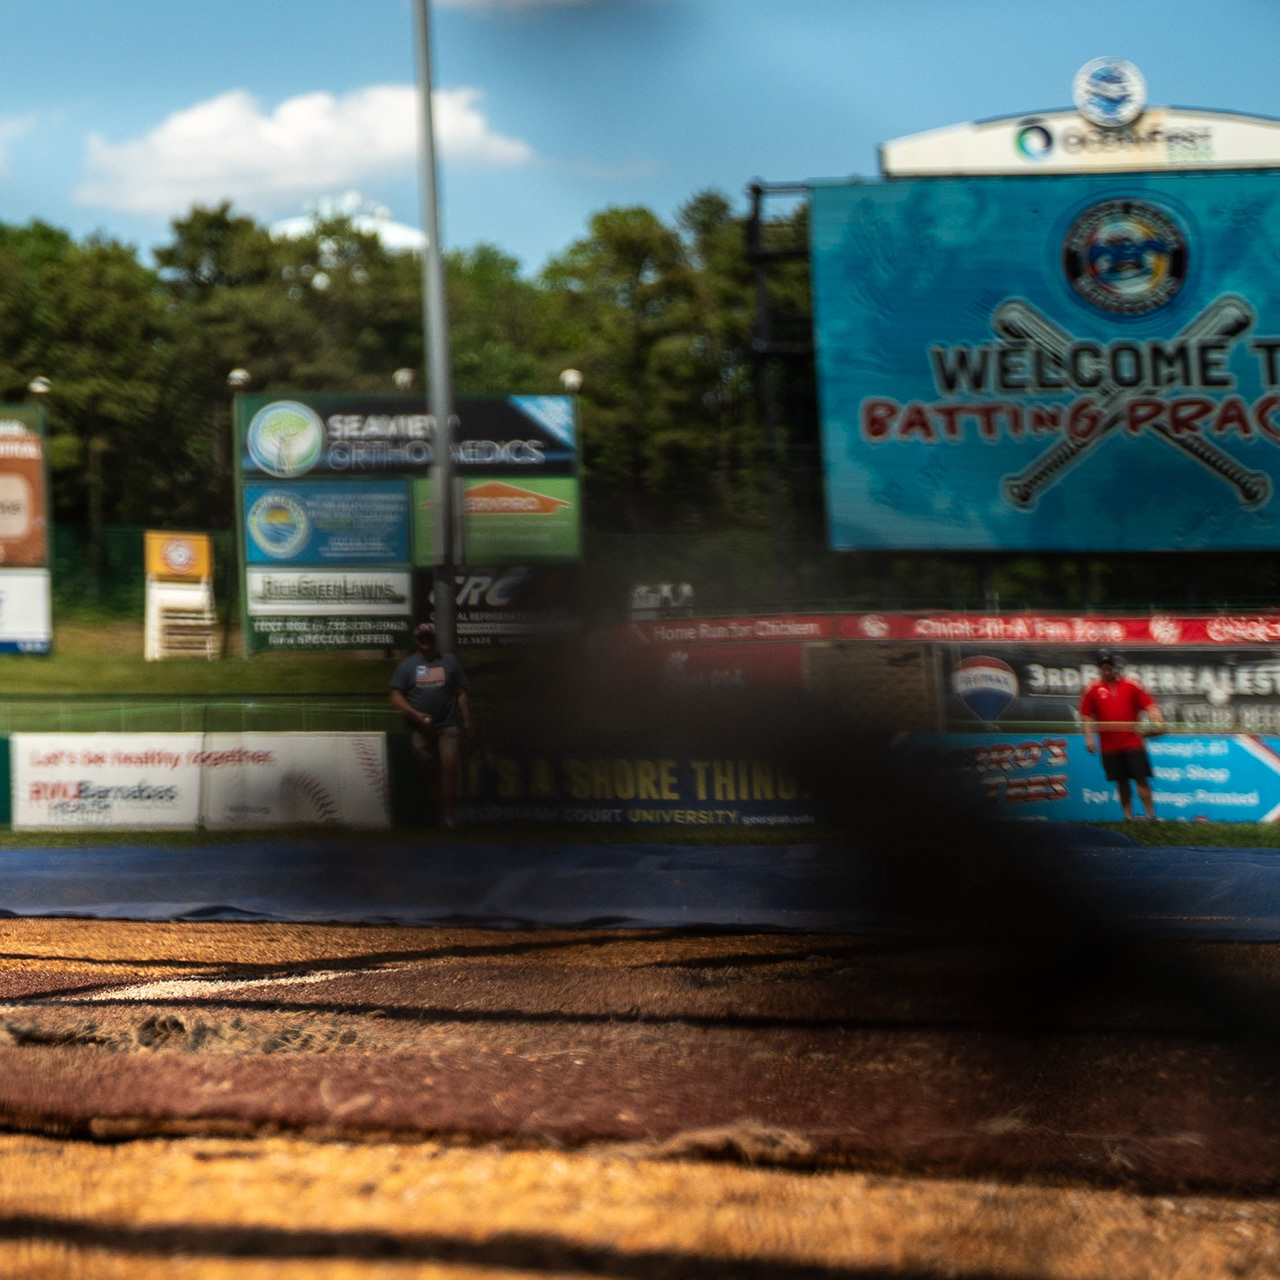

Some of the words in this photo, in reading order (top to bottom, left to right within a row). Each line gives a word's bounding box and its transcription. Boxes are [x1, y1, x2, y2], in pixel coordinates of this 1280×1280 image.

[934, 342, 1229, 392] WELCOME
[864, 401, 1100, 439] BATTING
[653, 624, 696, 641] Home
[562, 757, 680, 802] SHORE
[627, 808, 740, 825] UNIVERSITY
